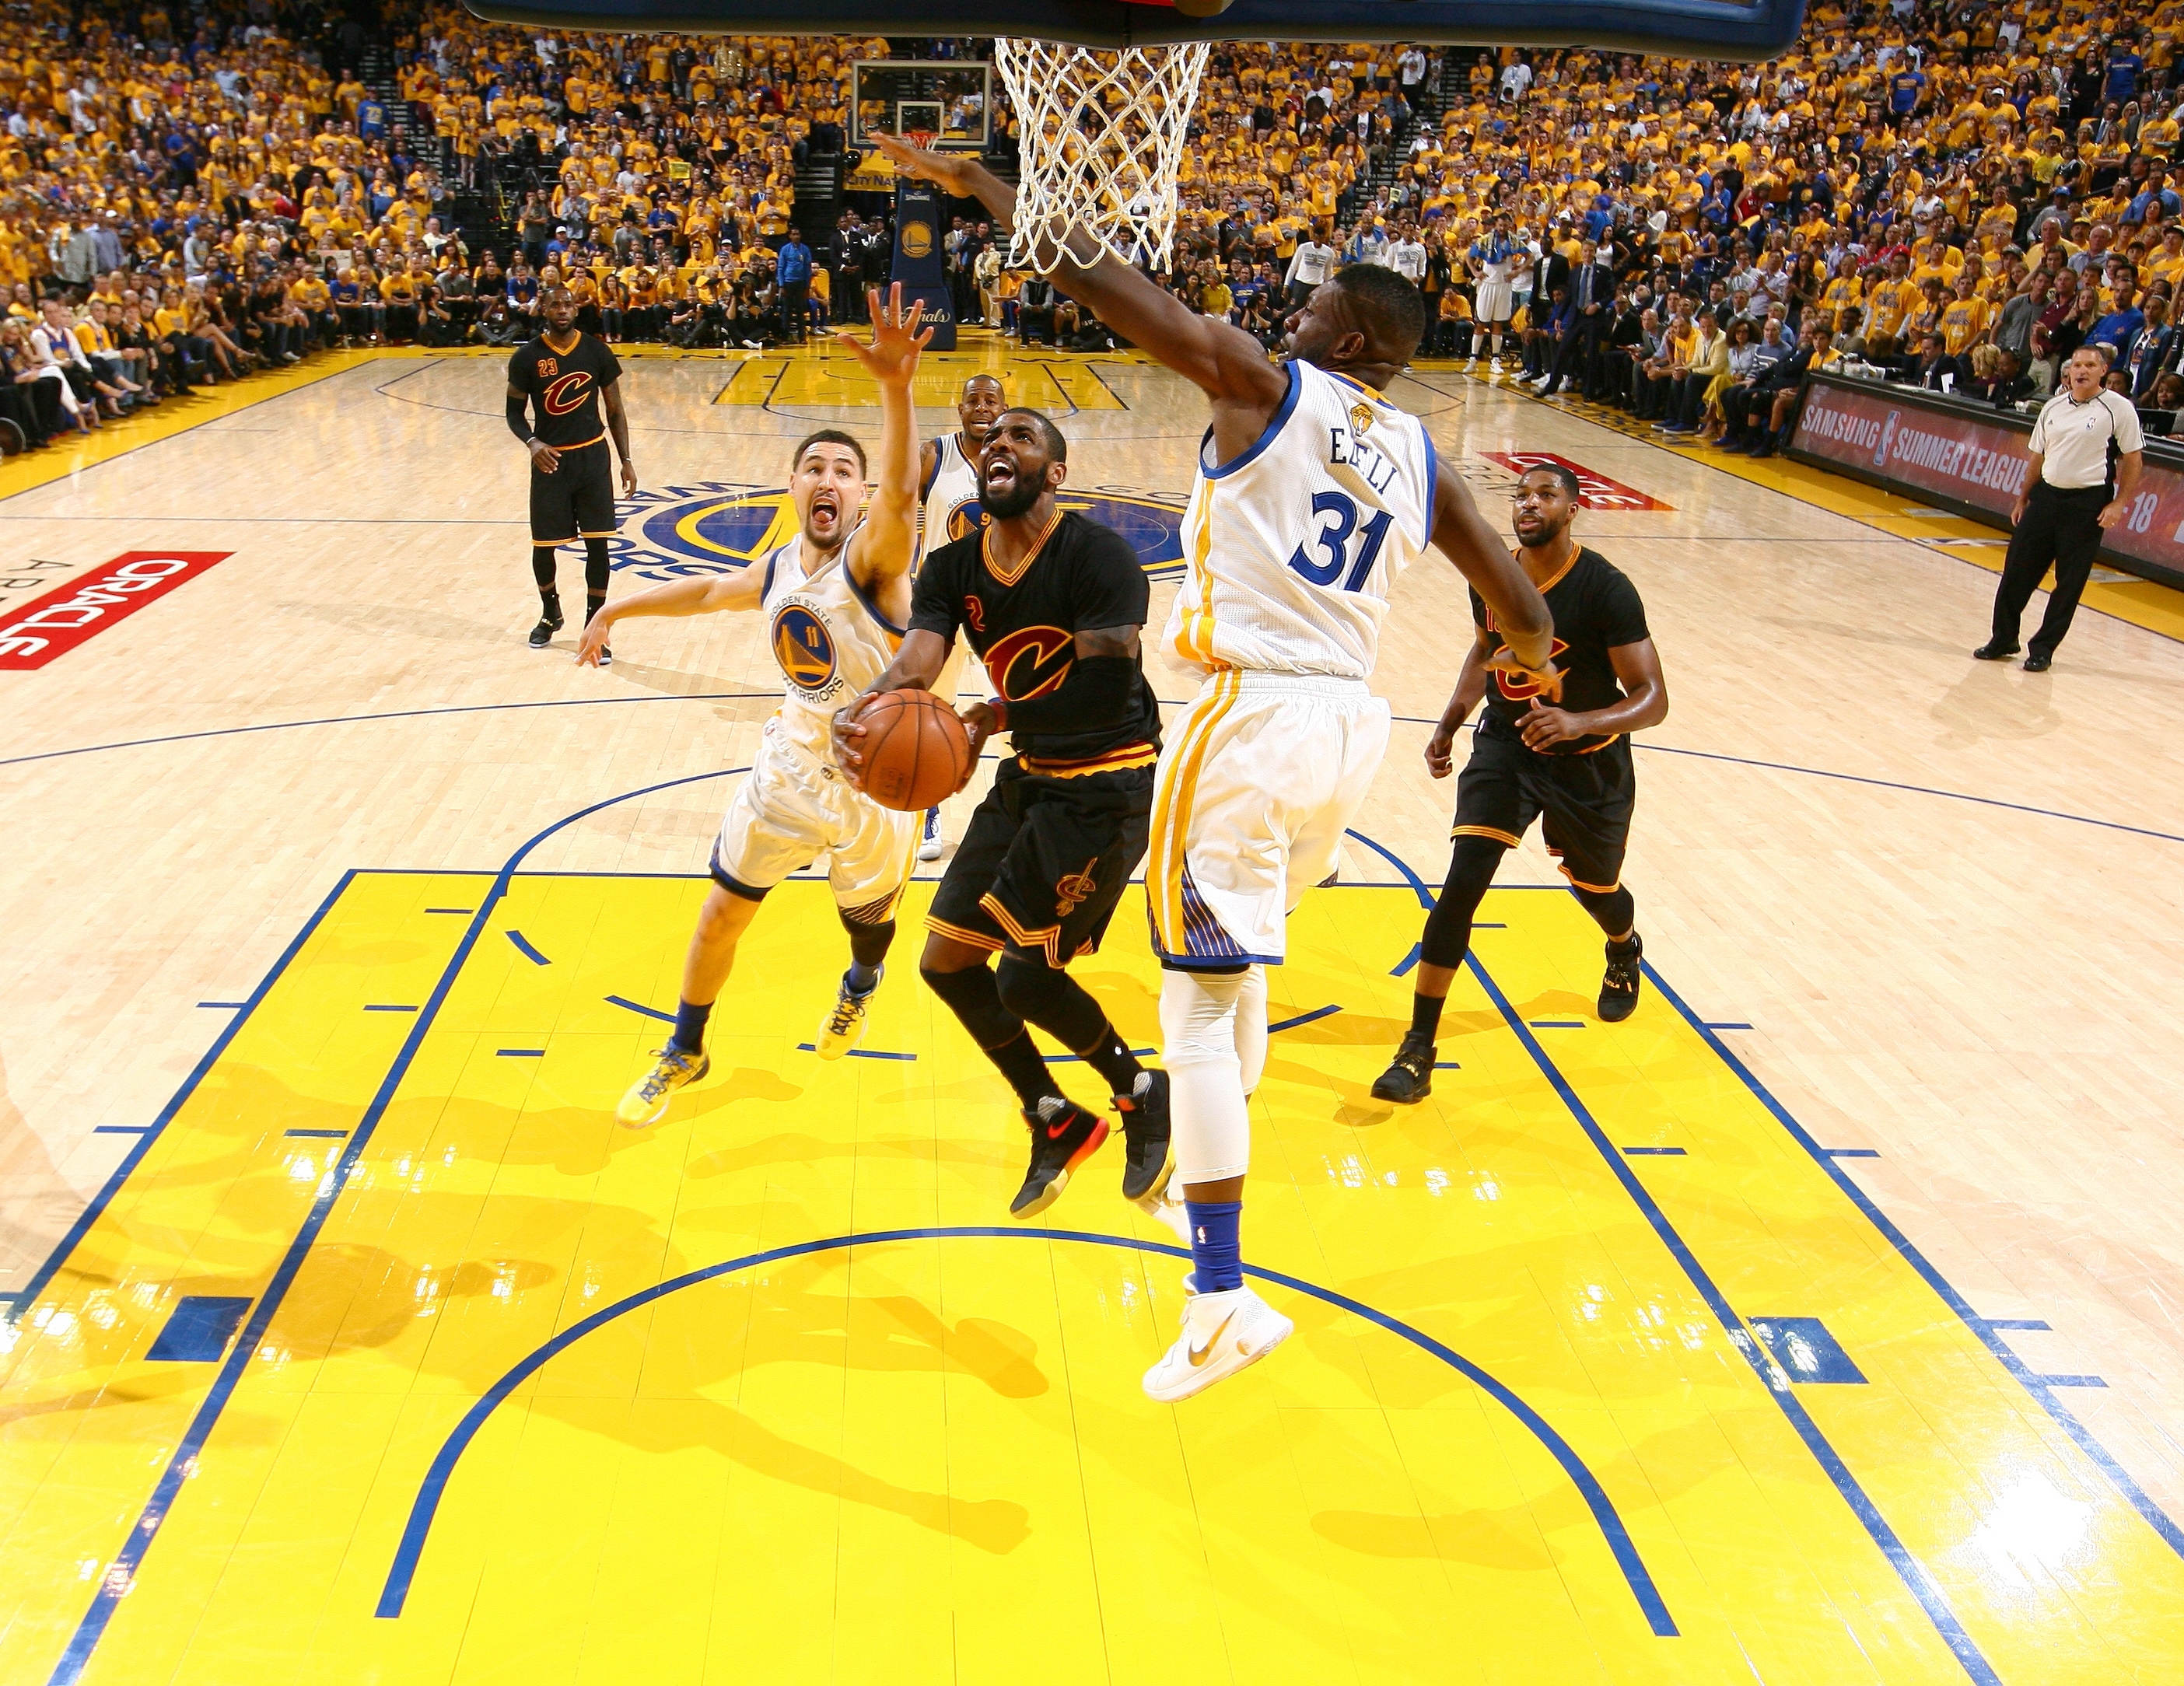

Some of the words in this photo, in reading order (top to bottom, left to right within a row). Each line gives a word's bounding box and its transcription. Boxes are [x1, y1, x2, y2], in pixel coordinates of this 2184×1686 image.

[537, 357, 558, 378] 23
[1801, 404, 1881, 449] SAMSUNG
[1892, 427, 1965, 477] SUMMER
[980, 512, 992, 526] 9
[1287, 490, 1395, 593] 31
[770, 595, 802, 621] GOLDEN
[803, 598, 834, 628] STATE
[964, 594, 986, 632] 2
[804, 625, 820, 648] 11
